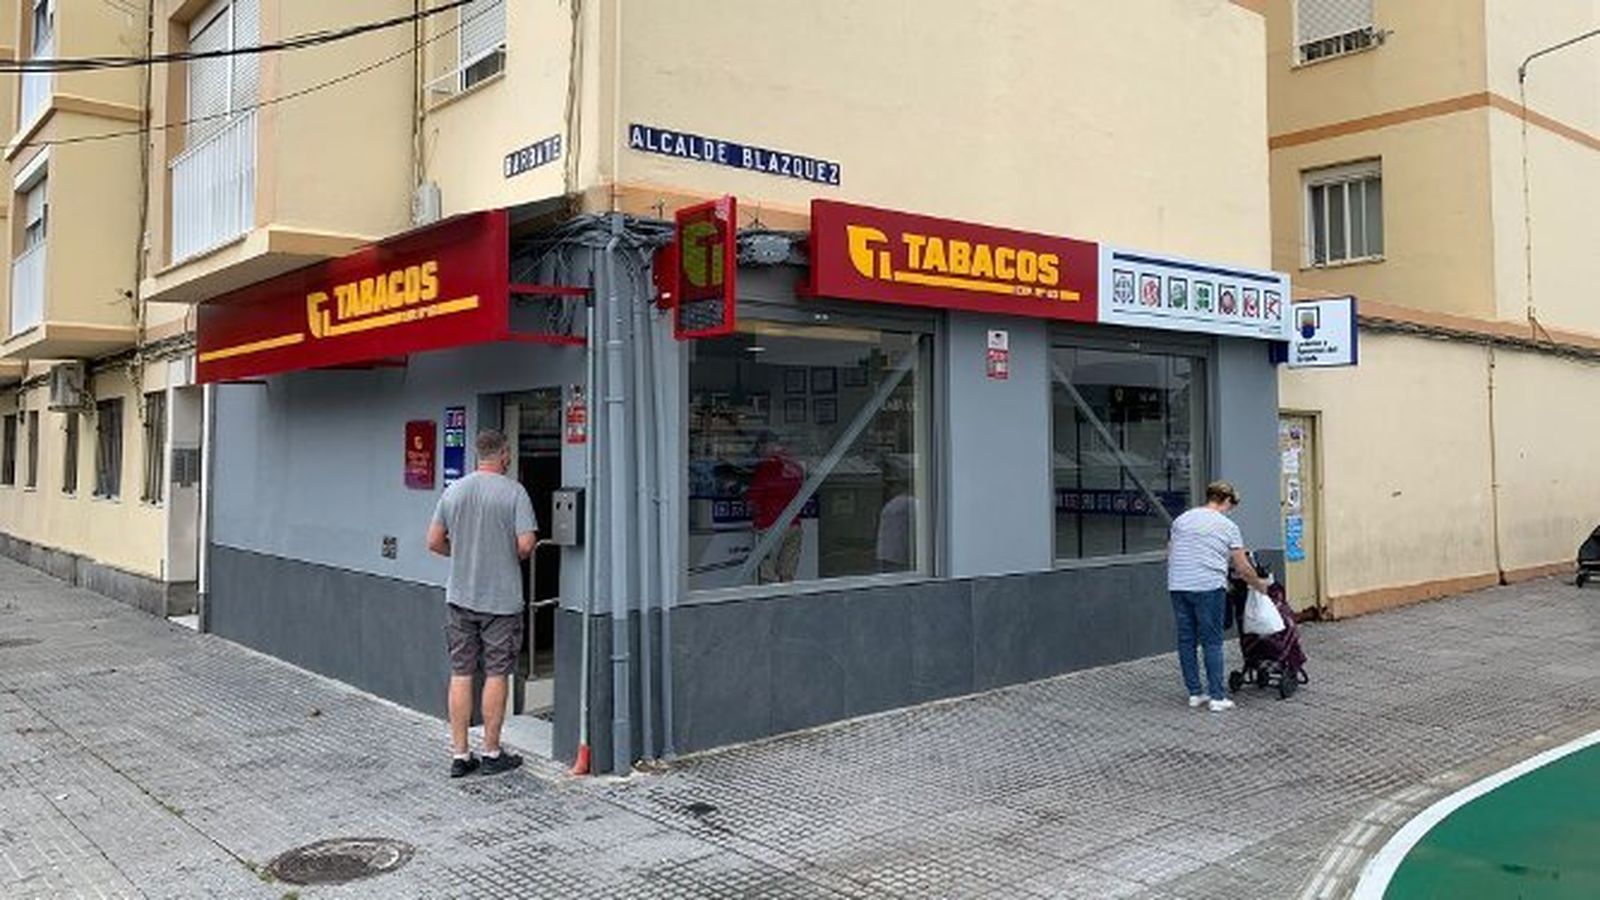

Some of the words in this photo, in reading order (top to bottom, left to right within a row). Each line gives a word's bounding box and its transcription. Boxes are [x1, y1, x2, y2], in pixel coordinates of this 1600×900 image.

[504, 137, 561, 177] BARBATE
[631, 126, 728, 163] ALCALDE
[742, 148, 839, 184] BLAZQUEZ
[902, 233, 1060, 286] TABACOS
[333, 260, 439, 320] TABACOS
